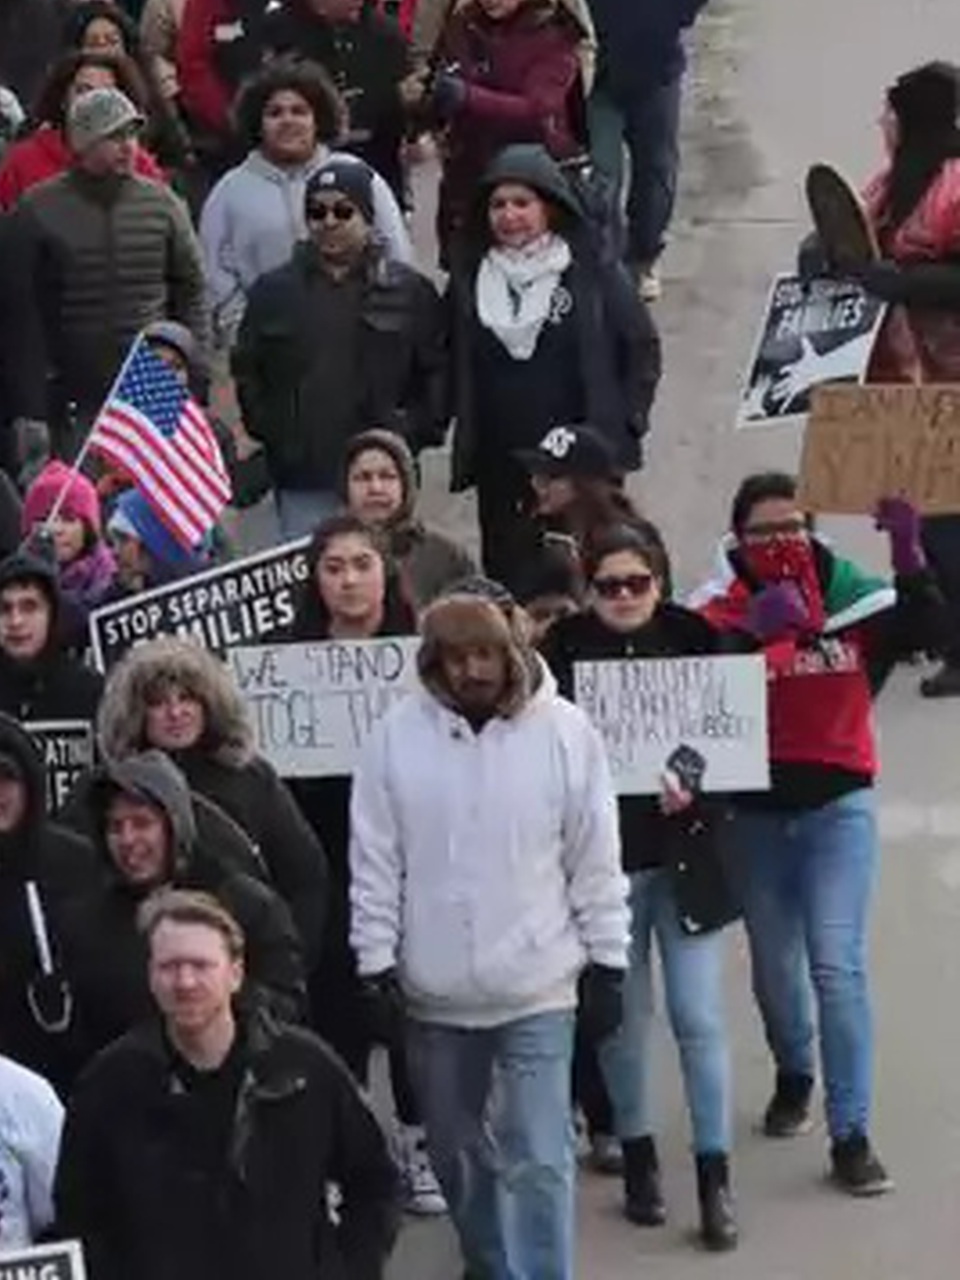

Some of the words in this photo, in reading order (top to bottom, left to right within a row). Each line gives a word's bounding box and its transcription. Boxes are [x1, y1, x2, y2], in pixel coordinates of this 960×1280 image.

[104, 609, 164, 646] STOP
[167, 554, 311, 623] SEPARATING
[133, 590, 297, 650] MILIES
[234, 649, 289, 689] WE
